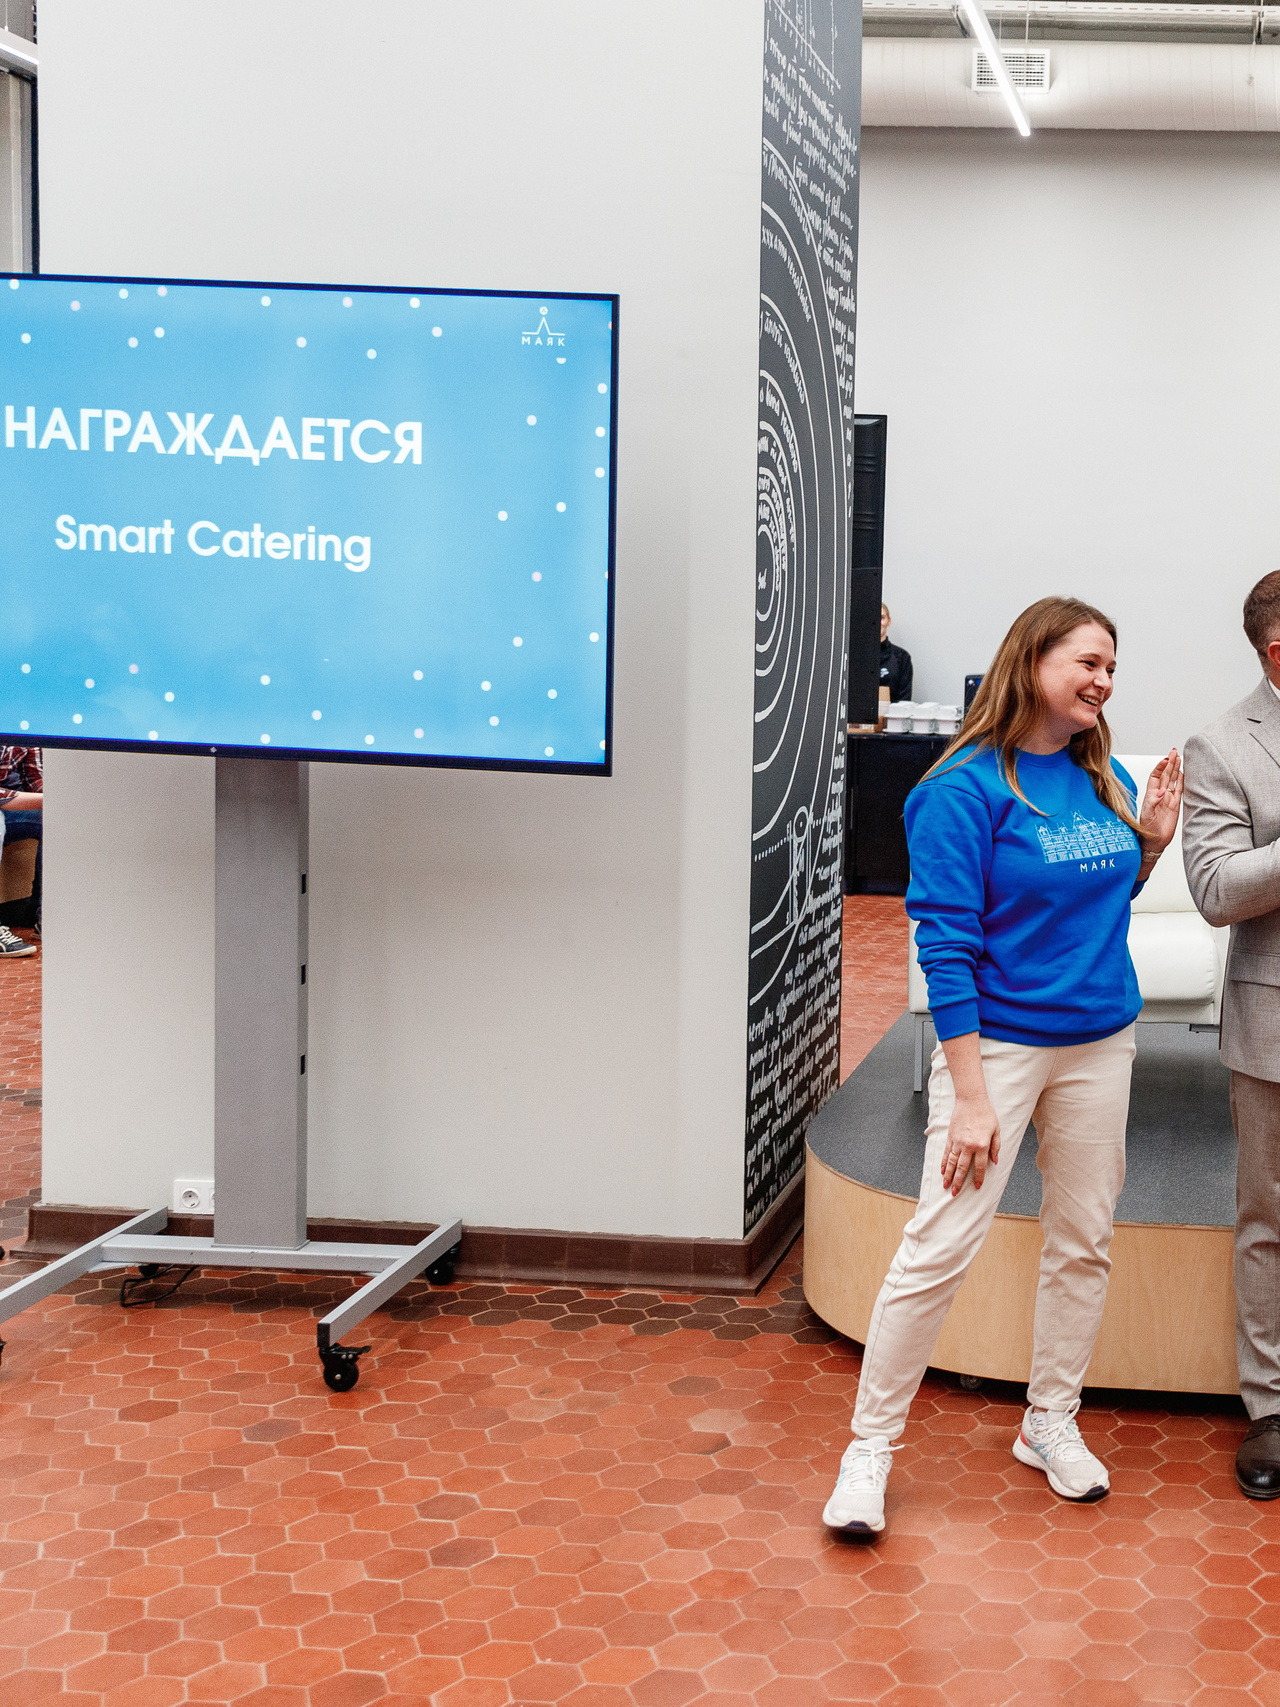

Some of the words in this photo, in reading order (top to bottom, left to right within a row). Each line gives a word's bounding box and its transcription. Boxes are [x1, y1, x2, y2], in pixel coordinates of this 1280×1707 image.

[521, 336, 565, 347] МАЯК
[5, 405, 423, 466] НАГРАЖДАЕТСЯ
[55, 514, 175, 554] Smart
[187, 520, 371, 573] Catering
[1079, 858, 1116, 873] МАЯК
